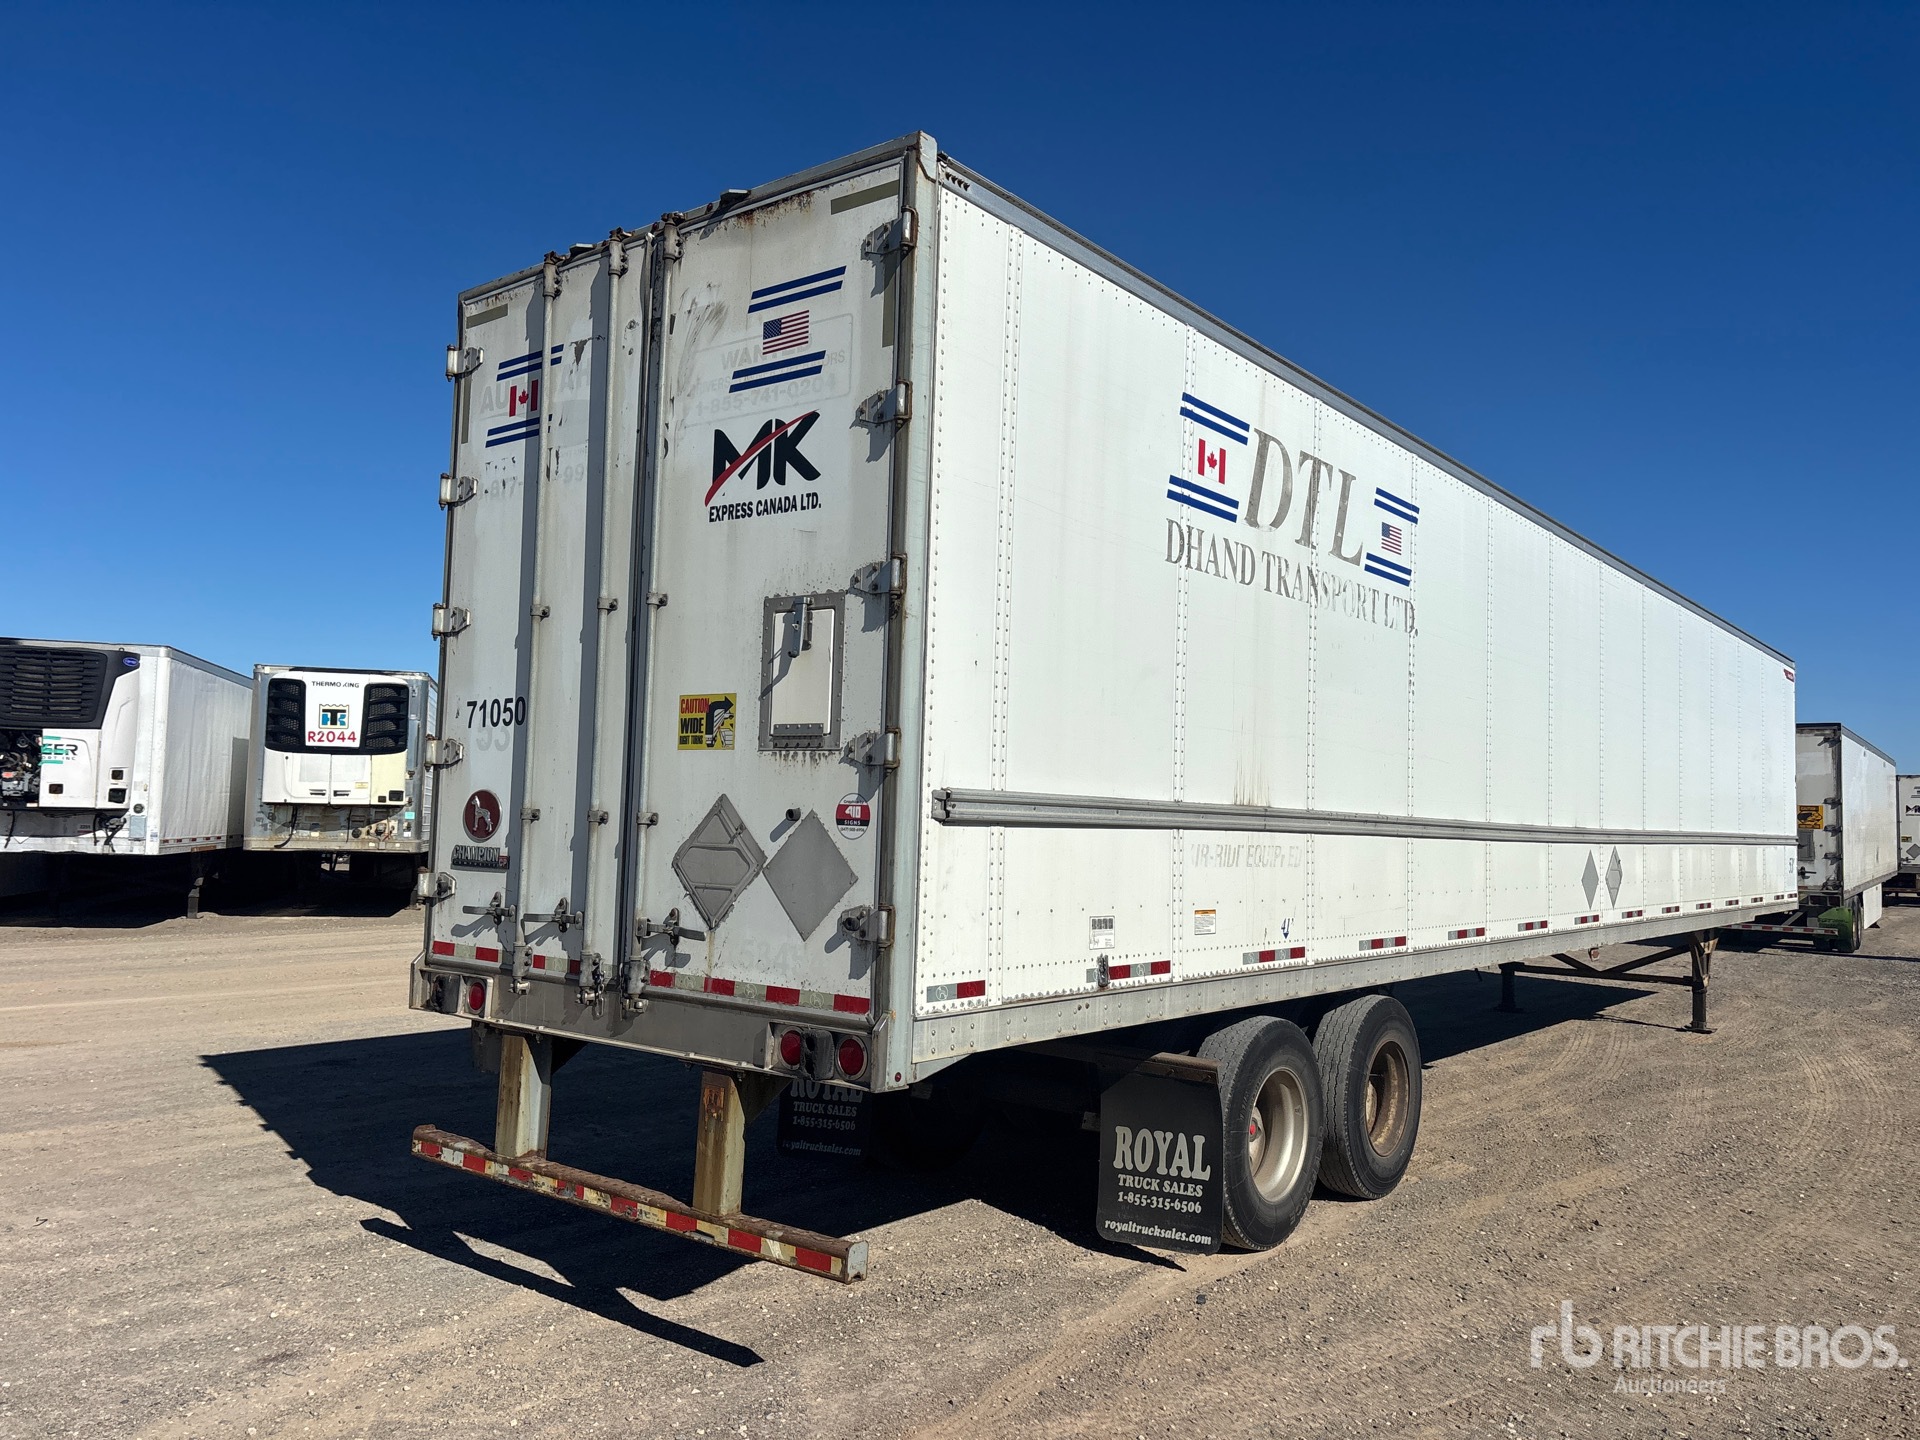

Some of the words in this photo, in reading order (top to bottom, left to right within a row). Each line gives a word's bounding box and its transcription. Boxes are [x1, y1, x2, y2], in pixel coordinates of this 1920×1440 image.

[708, 501, 753, 523] EXPRESS
[756, 497, 799, 517] CANADA
[801, 492, 822, 512] LTD.
[1244, 427, 1364, 566] DTL
[1165, 518, 1256, 586] DHAND
[1261, 550, 1380, 623] TRANSPORT
[467, 696, 526, 729] 71050
[681, 698, 709, 714] CAUTION
[308, 731, 357, 742] R2044
[681, 717, 704, 734] WIDE
[452, 845, 500, 862] CHAMPION
[793, 1101, 825, 1114] TRUCK
[826, 1104, 858, 1117] SALES
[1113, 1125, 1211, 1181] ROYAL
[1118, 1174, 1160, 1192] TRUCK
[1163, 1179, 1204, 1197] SALES
[1117, 1190, 1203, 1214] 1-855-315-6506
[1104, 1217, 1213, 1246] royaltrucksales.com
